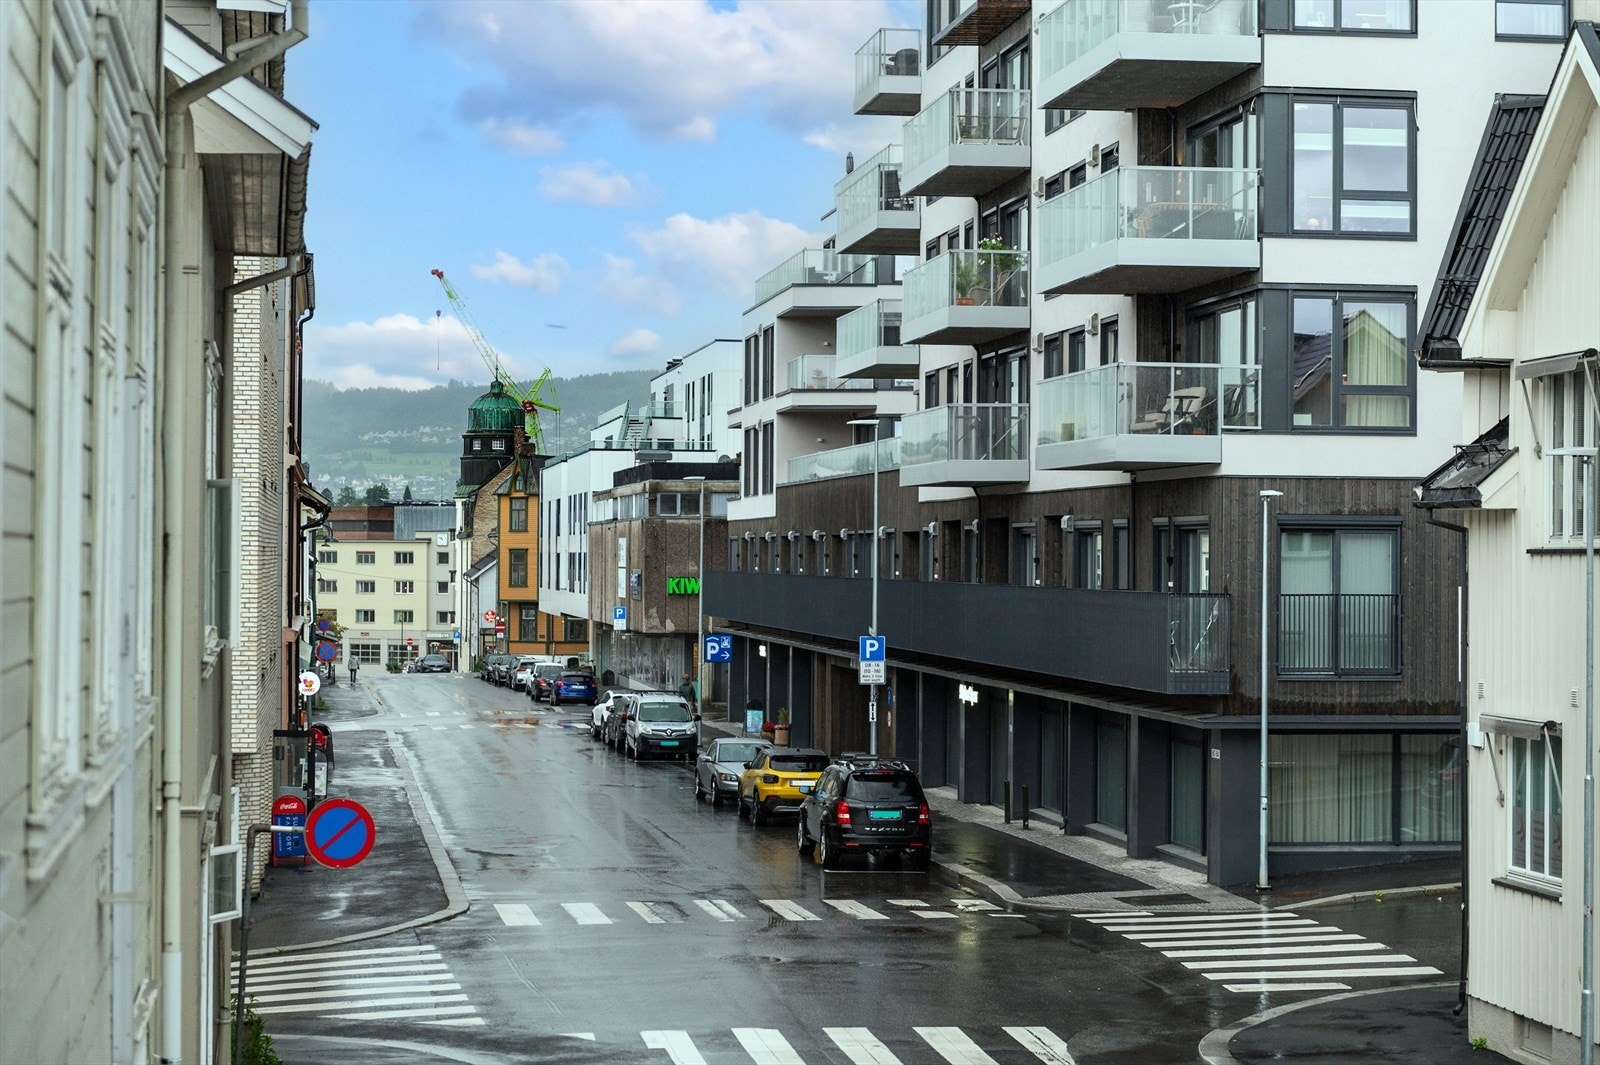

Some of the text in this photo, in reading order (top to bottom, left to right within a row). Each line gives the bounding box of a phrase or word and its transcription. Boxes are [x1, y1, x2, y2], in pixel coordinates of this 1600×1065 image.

[668, 577, 701, 594] KIW
[616, 609, 623, 618] P
[707, 642, 720, 660] P
[866, 640, 879, 658] P
